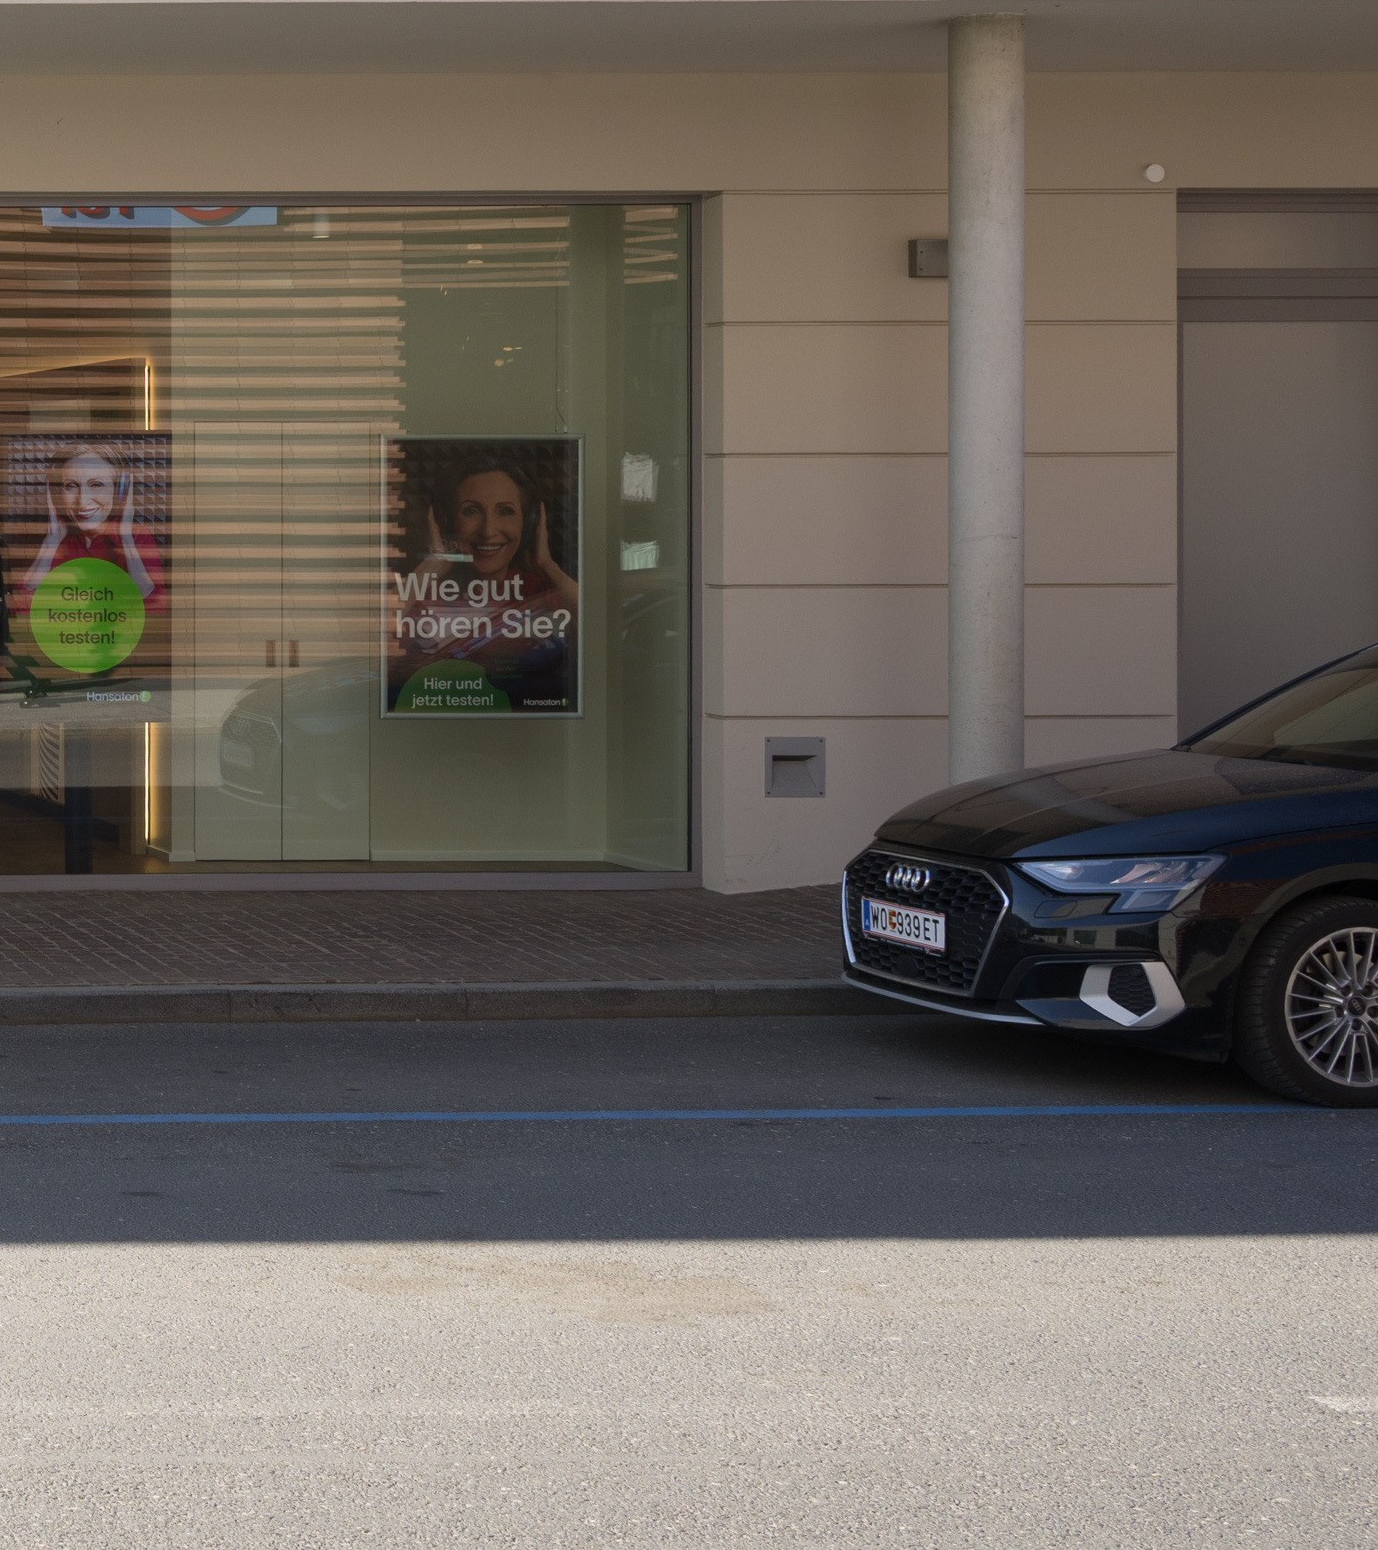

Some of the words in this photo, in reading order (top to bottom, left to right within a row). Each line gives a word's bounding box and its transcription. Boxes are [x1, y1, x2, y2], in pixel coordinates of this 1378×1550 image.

[61, 586, 114, 601] Gleich
[394, 572, 460, 601] Wie
[467, 574, 524, 608] gut
[48, 608, 127, 623] kostenlos
[396, 609, 492, 638] hören
[501, 609, 571, 639] Sie?
[59, 630, 115, 644] testen!
[424, 678, 452, 690] Hier
[456, 678, 482, 690] und
[86, 691, 139, 702] Hansaton
[412, 694, 443, 708] jetzt
[446, 694, 494, 706] testen!
[523, 698, 561, 706] Hansaton
[871, 904, 888, 931] WO
[896, 912, 921, 939] 939
[923, 917, 939, 943] ET
